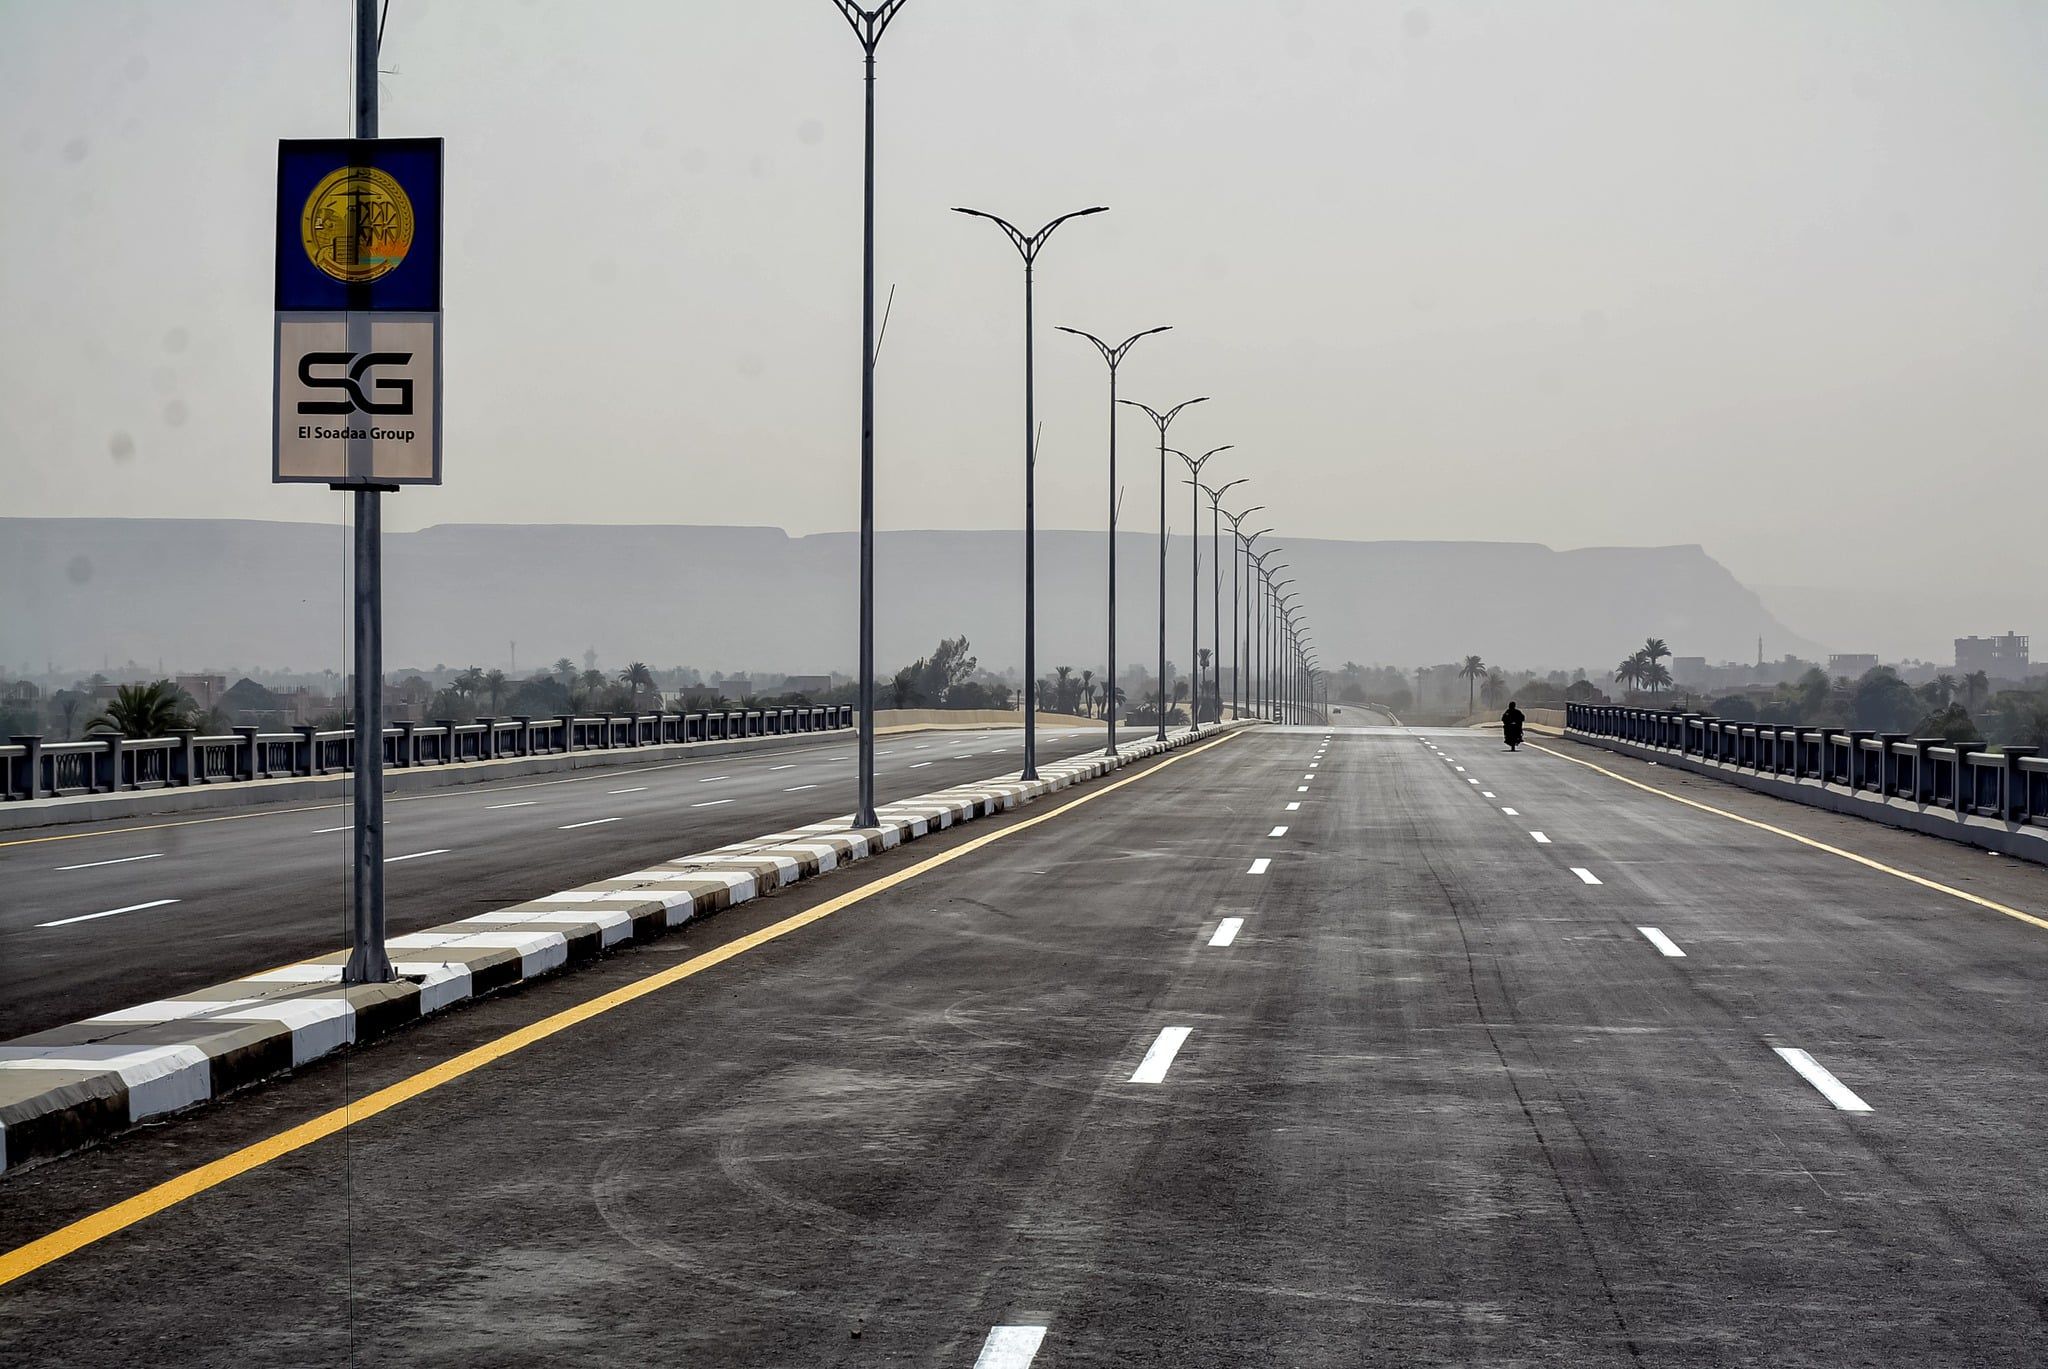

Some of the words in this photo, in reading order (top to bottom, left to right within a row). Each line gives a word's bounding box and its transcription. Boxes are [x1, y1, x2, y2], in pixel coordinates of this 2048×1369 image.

[297, 352, 414, 415] SG
[298, 426, 311, 439] El
[314, 426, 367, 439] Soadaa
[369, 427, 415, 443] Group
